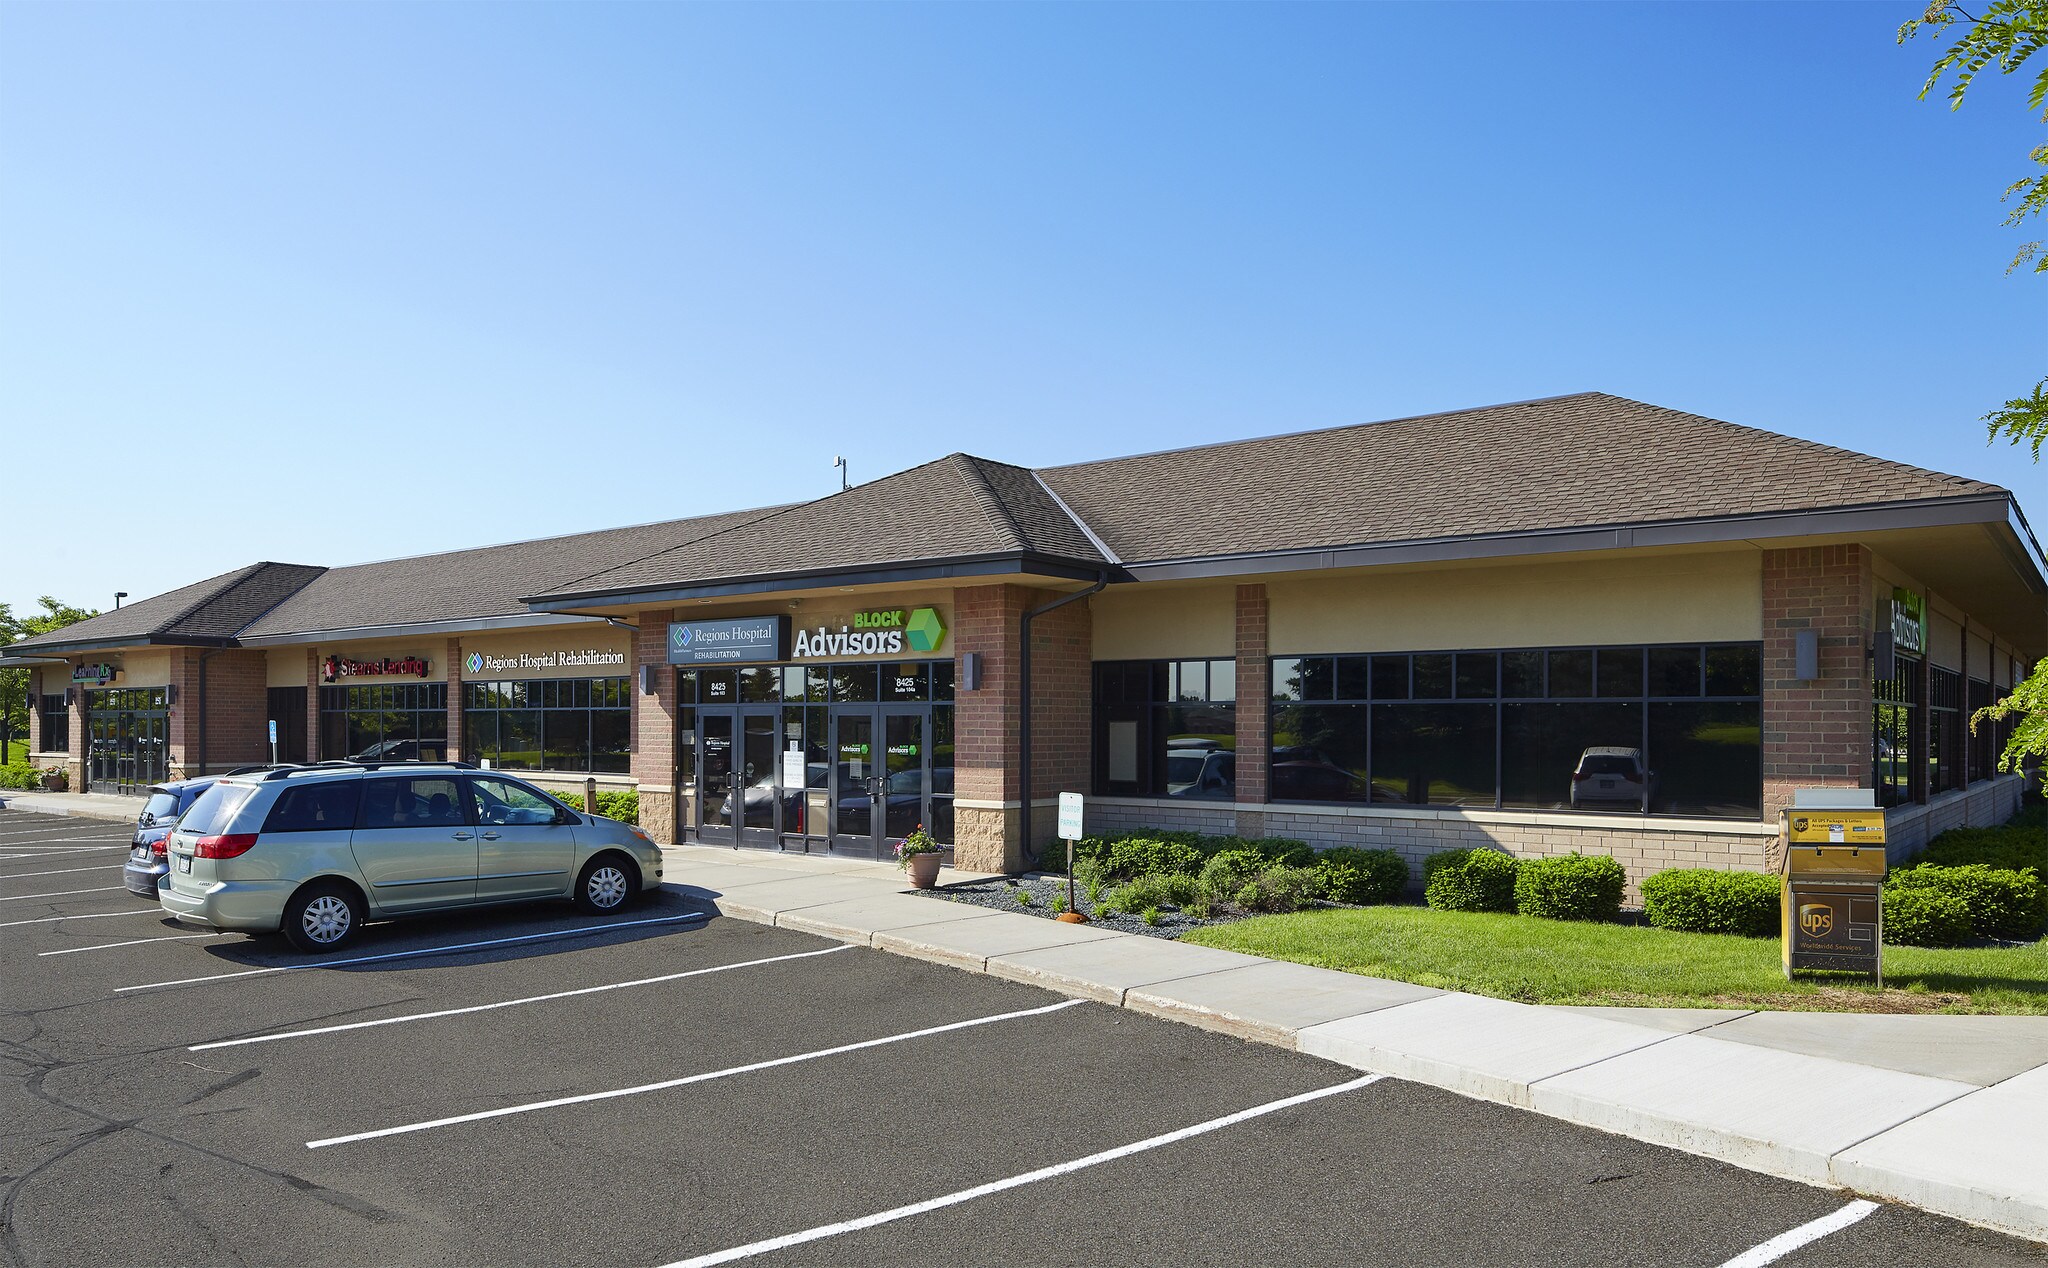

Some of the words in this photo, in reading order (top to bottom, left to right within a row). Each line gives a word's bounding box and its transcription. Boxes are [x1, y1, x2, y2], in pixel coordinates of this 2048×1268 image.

[853, 610, 902, 628] BLOCK
[695, 627, 730, 644] Regions
[732, 624, 772, 643] Hospital
[793, 625, 902, 658] Advisors
[486, 652, 518, 673] Regions
[520, 650, 557, 671] Hospital
[559, 648, 625, 667] Rehabilitation
[694, 650, 741, 660] REHABILITATION
[340, 658, 380, 677] Stearns
[382, 656, 424, 678] Lending
[711, 682, 726, 691] 8425
[896, 677, 914, 687] 8425
[1794, 821, 1808, 831] ups
[1802, 914, 1831, 933] ups
[1800, 942, 1834, 950] Worldwide
[1835, 944, 1862, 952] Services
